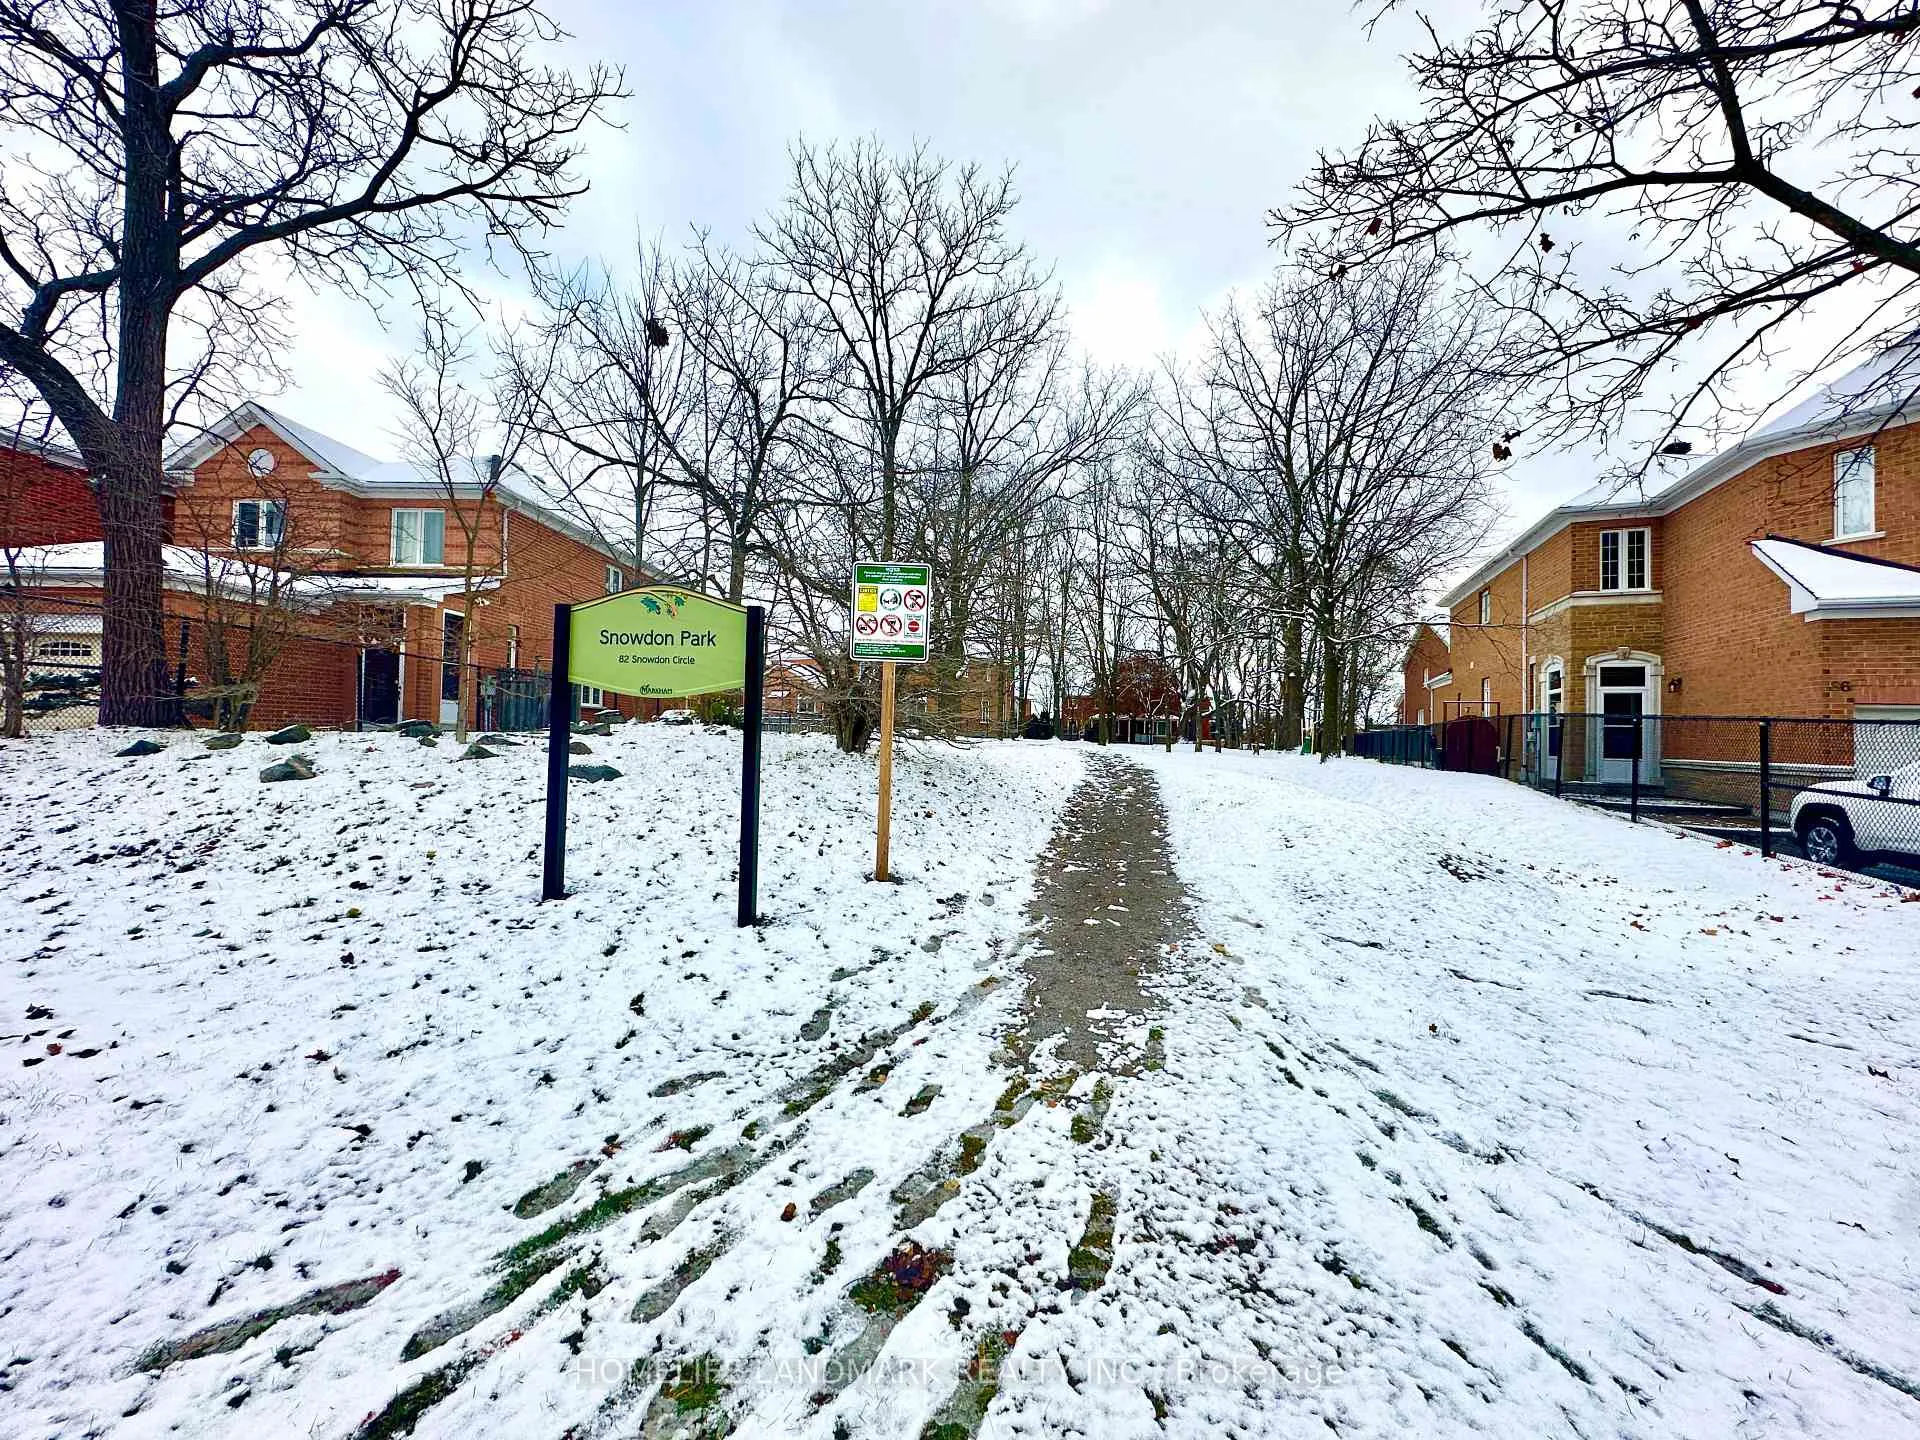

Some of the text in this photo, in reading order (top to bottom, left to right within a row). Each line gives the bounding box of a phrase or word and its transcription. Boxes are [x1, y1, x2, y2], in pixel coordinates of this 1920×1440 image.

[599, 629, 717, 647] Snowdon Park
[618, 654, 695, 665] 82 Snowdon Circle
